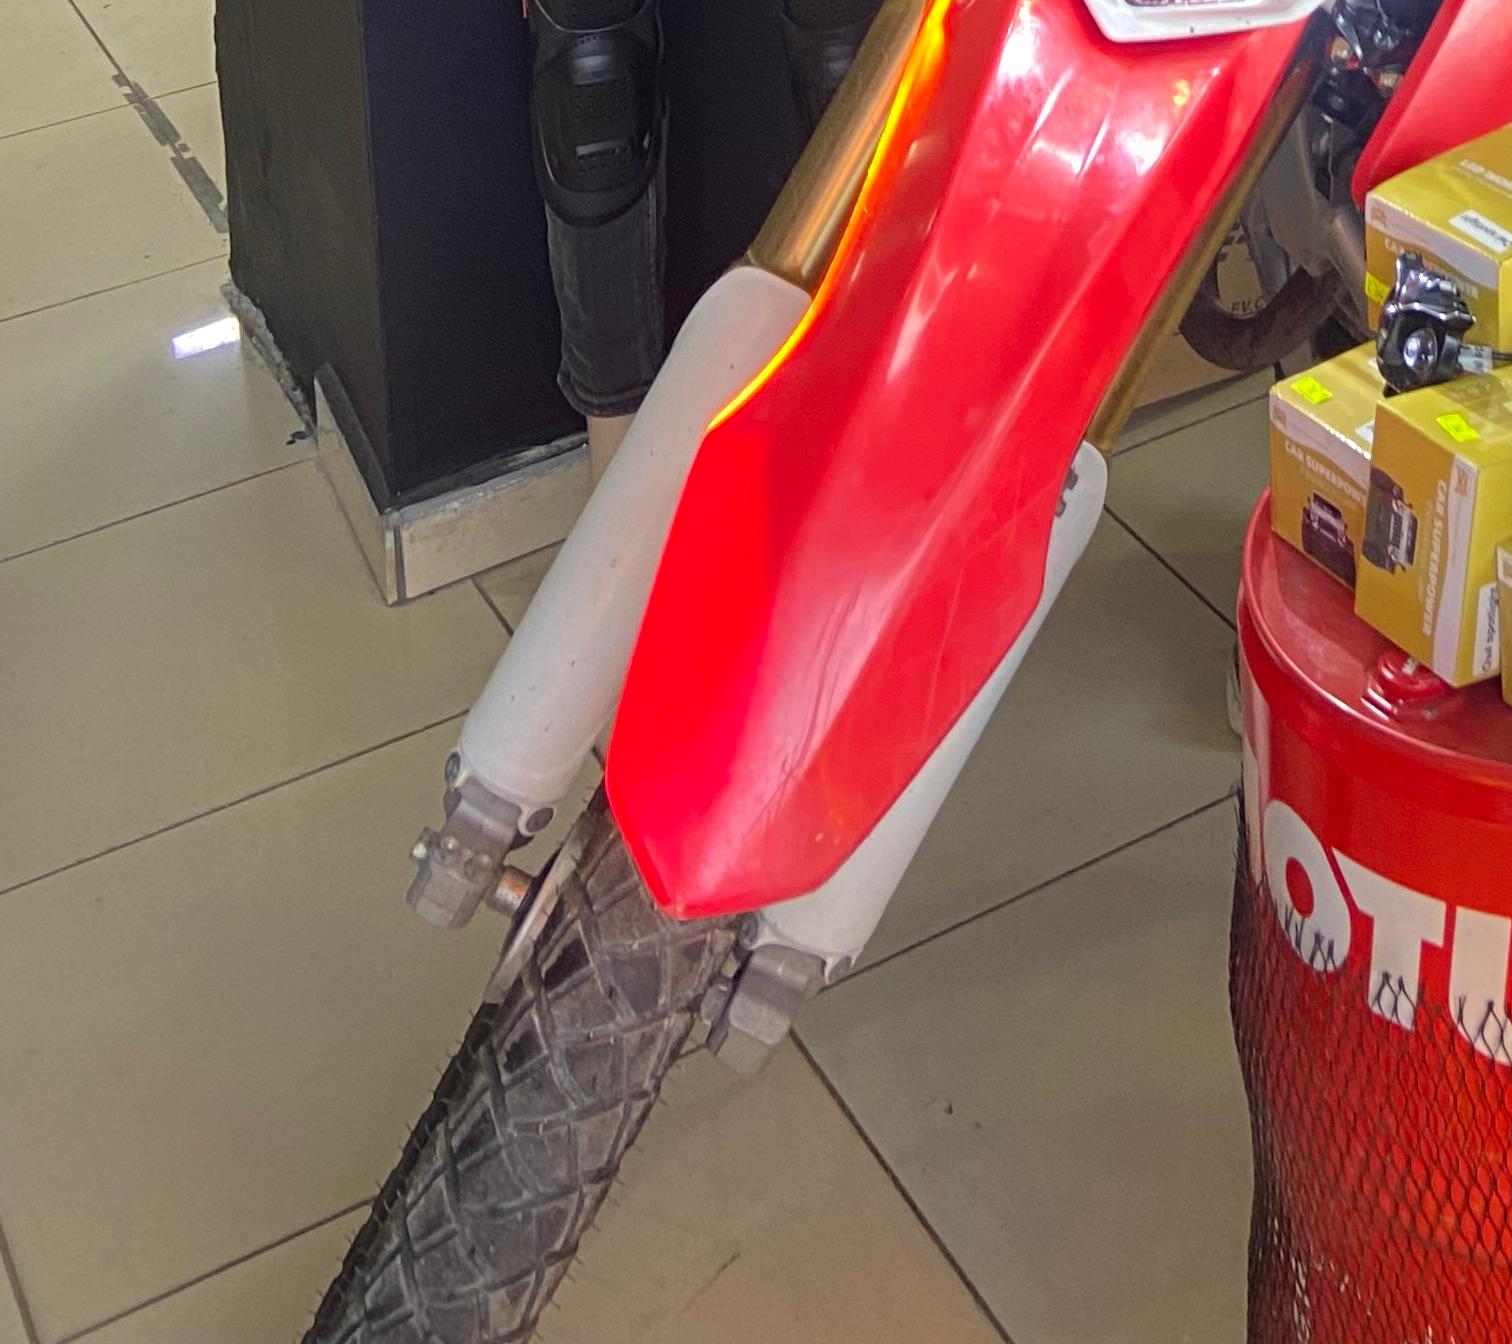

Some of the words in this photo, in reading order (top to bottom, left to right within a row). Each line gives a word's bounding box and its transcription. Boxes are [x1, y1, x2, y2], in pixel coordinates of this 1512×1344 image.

[1285, 440, 1304, 462] CAR
[1434, 479, 1447, 513] CAR
[1423, 516, 1443, 636] SUPERPOWER
